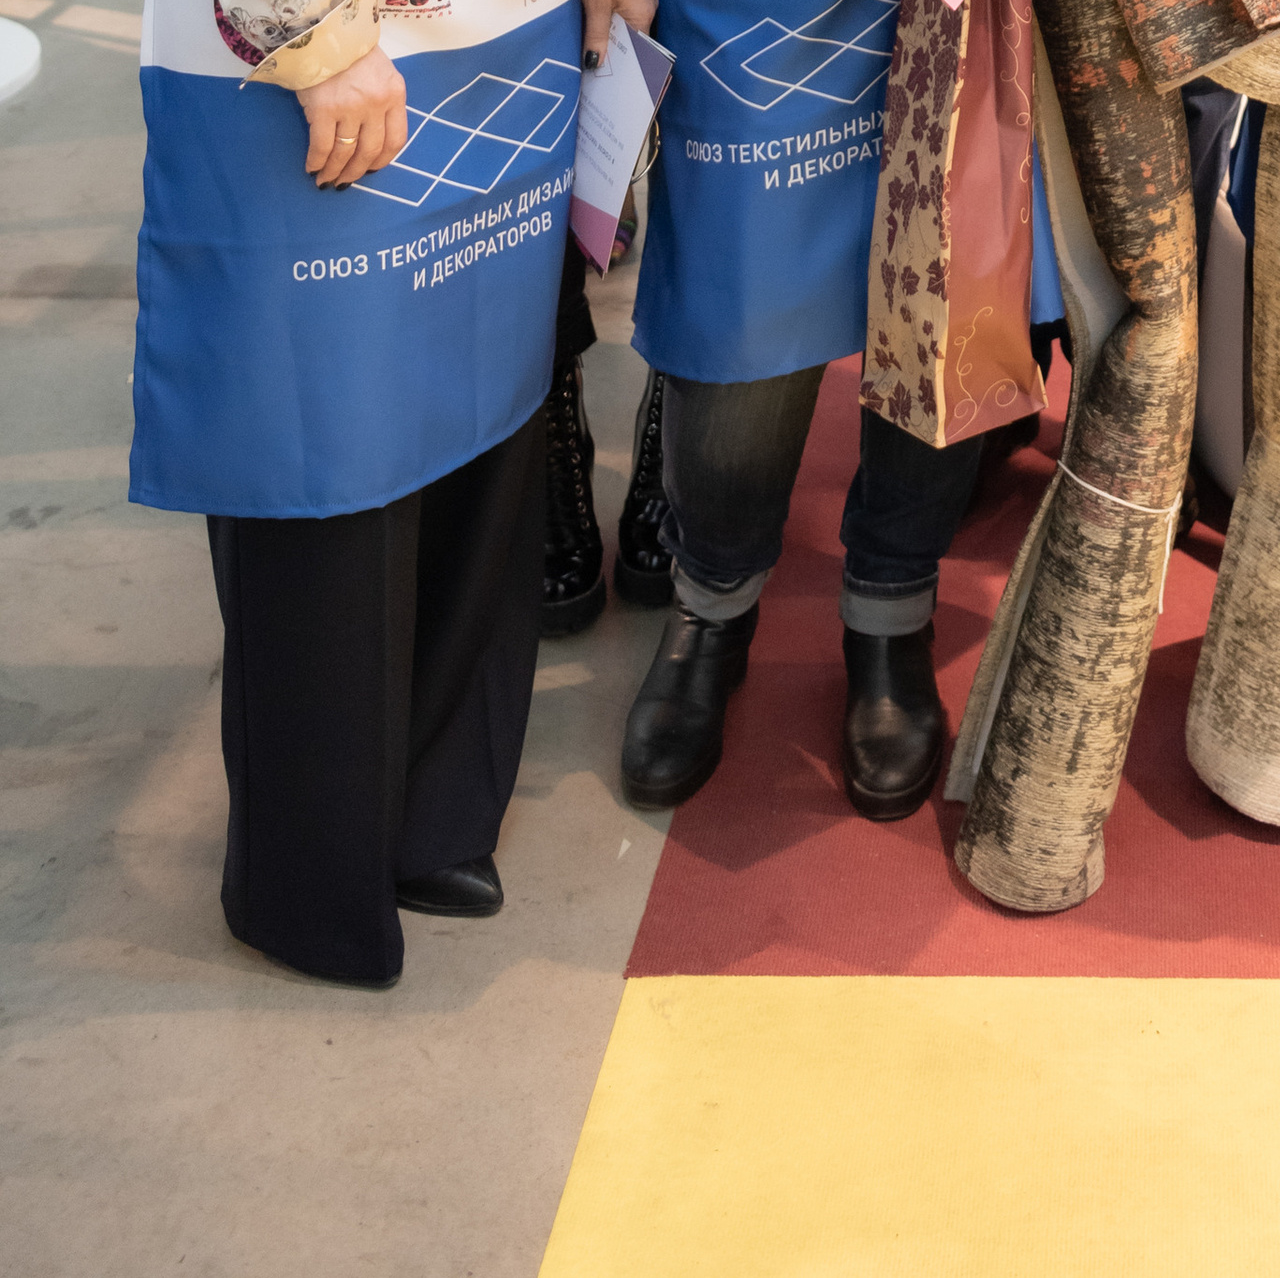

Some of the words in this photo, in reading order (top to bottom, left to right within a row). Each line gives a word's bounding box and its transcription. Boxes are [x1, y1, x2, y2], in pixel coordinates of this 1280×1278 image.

[686, 139, 723, 163] СОЮЗ
[764, 168, 780, 191] И
[292, 254, 369, 282] СОЮЗ
[377, 198, 514, 271] ТЕКСТИЛЬНЫХ
[413, 269, 427, 292] И
[430, 210, 553, 288] ДЕКОРАТОРОВ
